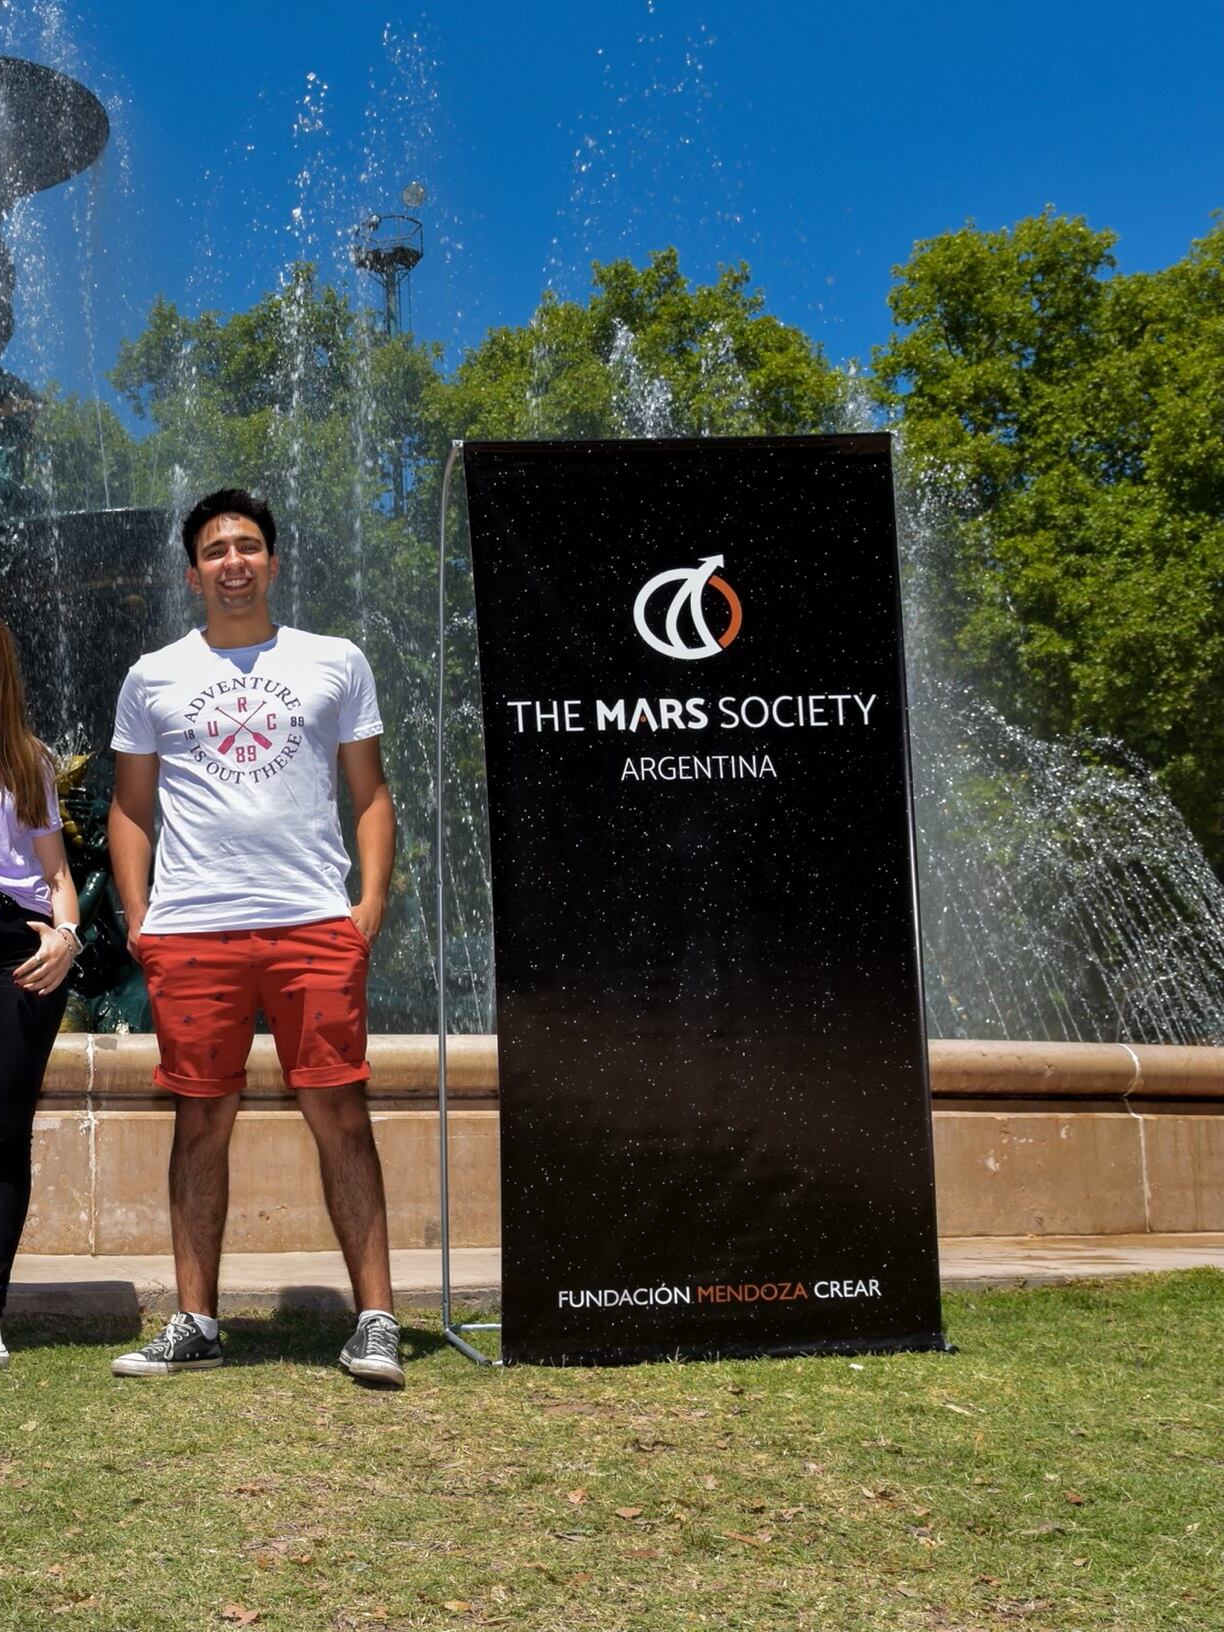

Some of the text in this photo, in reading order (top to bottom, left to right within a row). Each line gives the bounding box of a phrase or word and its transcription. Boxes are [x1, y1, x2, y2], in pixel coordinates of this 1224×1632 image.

[184, 676, 302, 724] ADVENTURE
[505, 694, 878, 733] THE MARS SOCIETY
[207, 696, 277, 738] U R C
[290, 716, 305, 727] 89
[183, 729, 196, 741] 18
[190, 733, 302, 784] IS OUT THERE
[235, 745, 257, 763] 89
[619, 754, 778, 782] ARGENTINA
[558, 1279, 882, 1308] FUNDACIÓN MENDOZA CREAR
